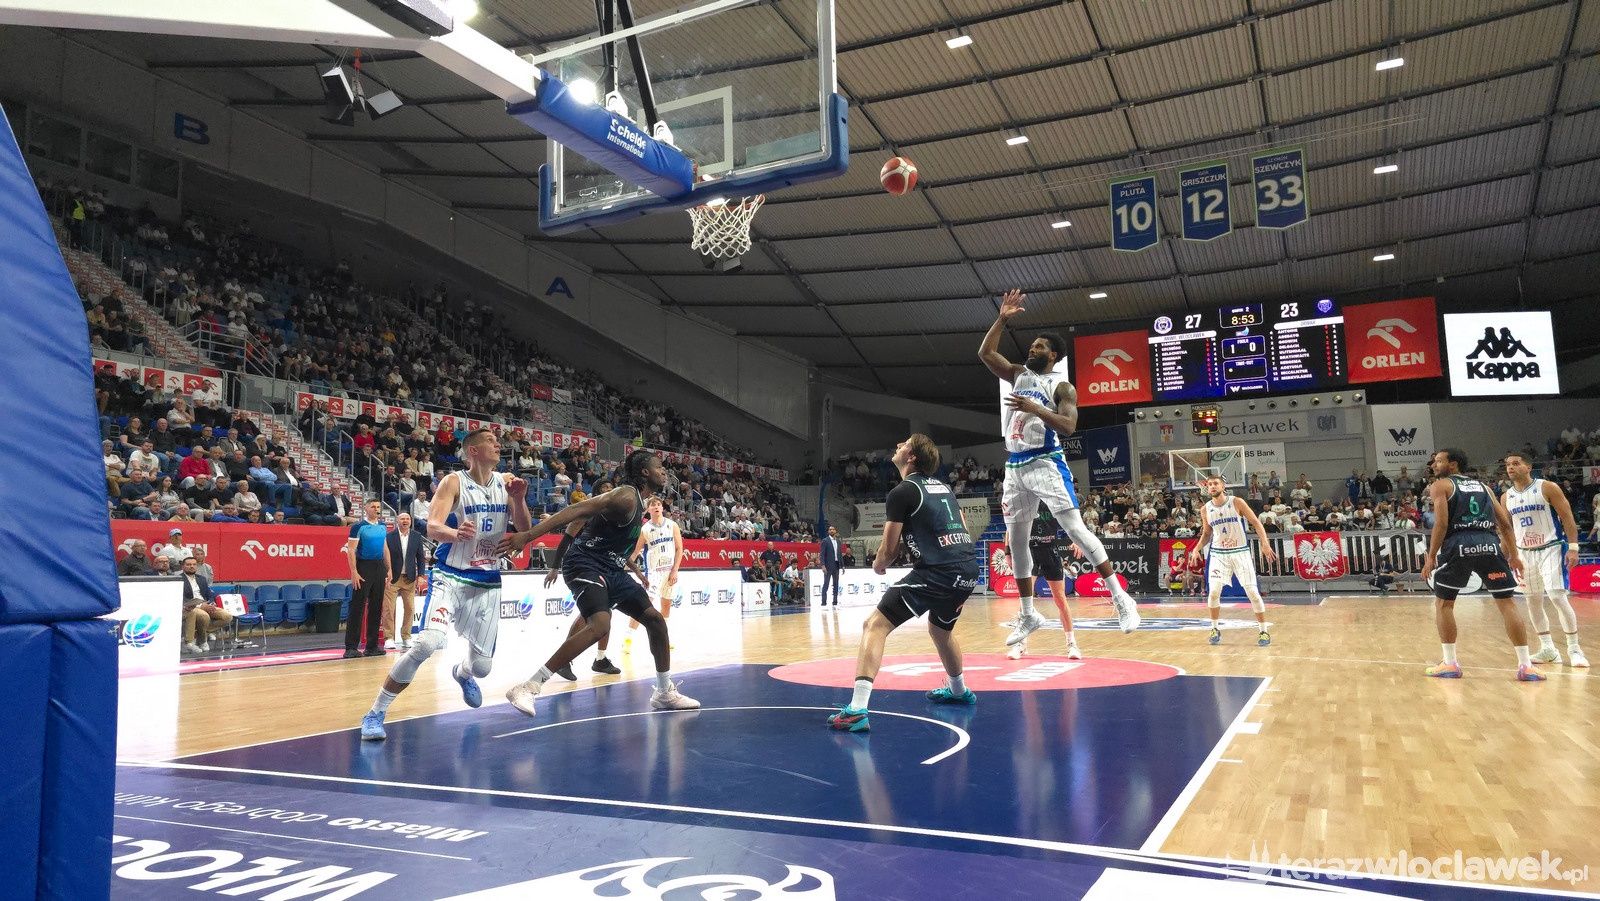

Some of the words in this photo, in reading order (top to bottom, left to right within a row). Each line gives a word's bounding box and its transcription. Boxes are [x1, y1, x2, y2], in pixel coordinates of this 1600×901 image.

[175, 112, 210, 145] B
[1254, 159, 1301, 174] SZEWCZYK
[1181, 173, 1226, 187] GRISZCZUK
[1120, 187, 1146, 198] PLUTA
[1257, 175, 1303, 211] 33
[1186, 189, 1225, 223] 12
[1115, 201, 1152, 234] 10
[545, 276, 575, 299] A
[1280, 302, 1299, 318] 23
[1185, 314, 1202, 329] 27
[1231, 314, 1255, 325] 8:53
[1230, 344, 1235, 354] 1
[1249, 342, 1256, 352] 0
[1362, 351, 1425, 369] ORLEN
[1466, 361, 1541, 381] Kappa
[1088, 379, 1140, 394] ORLEN
[1257, 449, 1275, 457] Bank
[1469, 496, 1480, 515] 6
[481, 519, 493, 532] 16
[1520, 516, 1534, 528] 20
[268, 545, 314, 557] ORLEN
[692, 551, 710, 560] ORLEN
[728, 551, 744, 560] ORLEN
[173, 801, 329, 824] dobrego
[328, 817, 488, 842] Miasto
